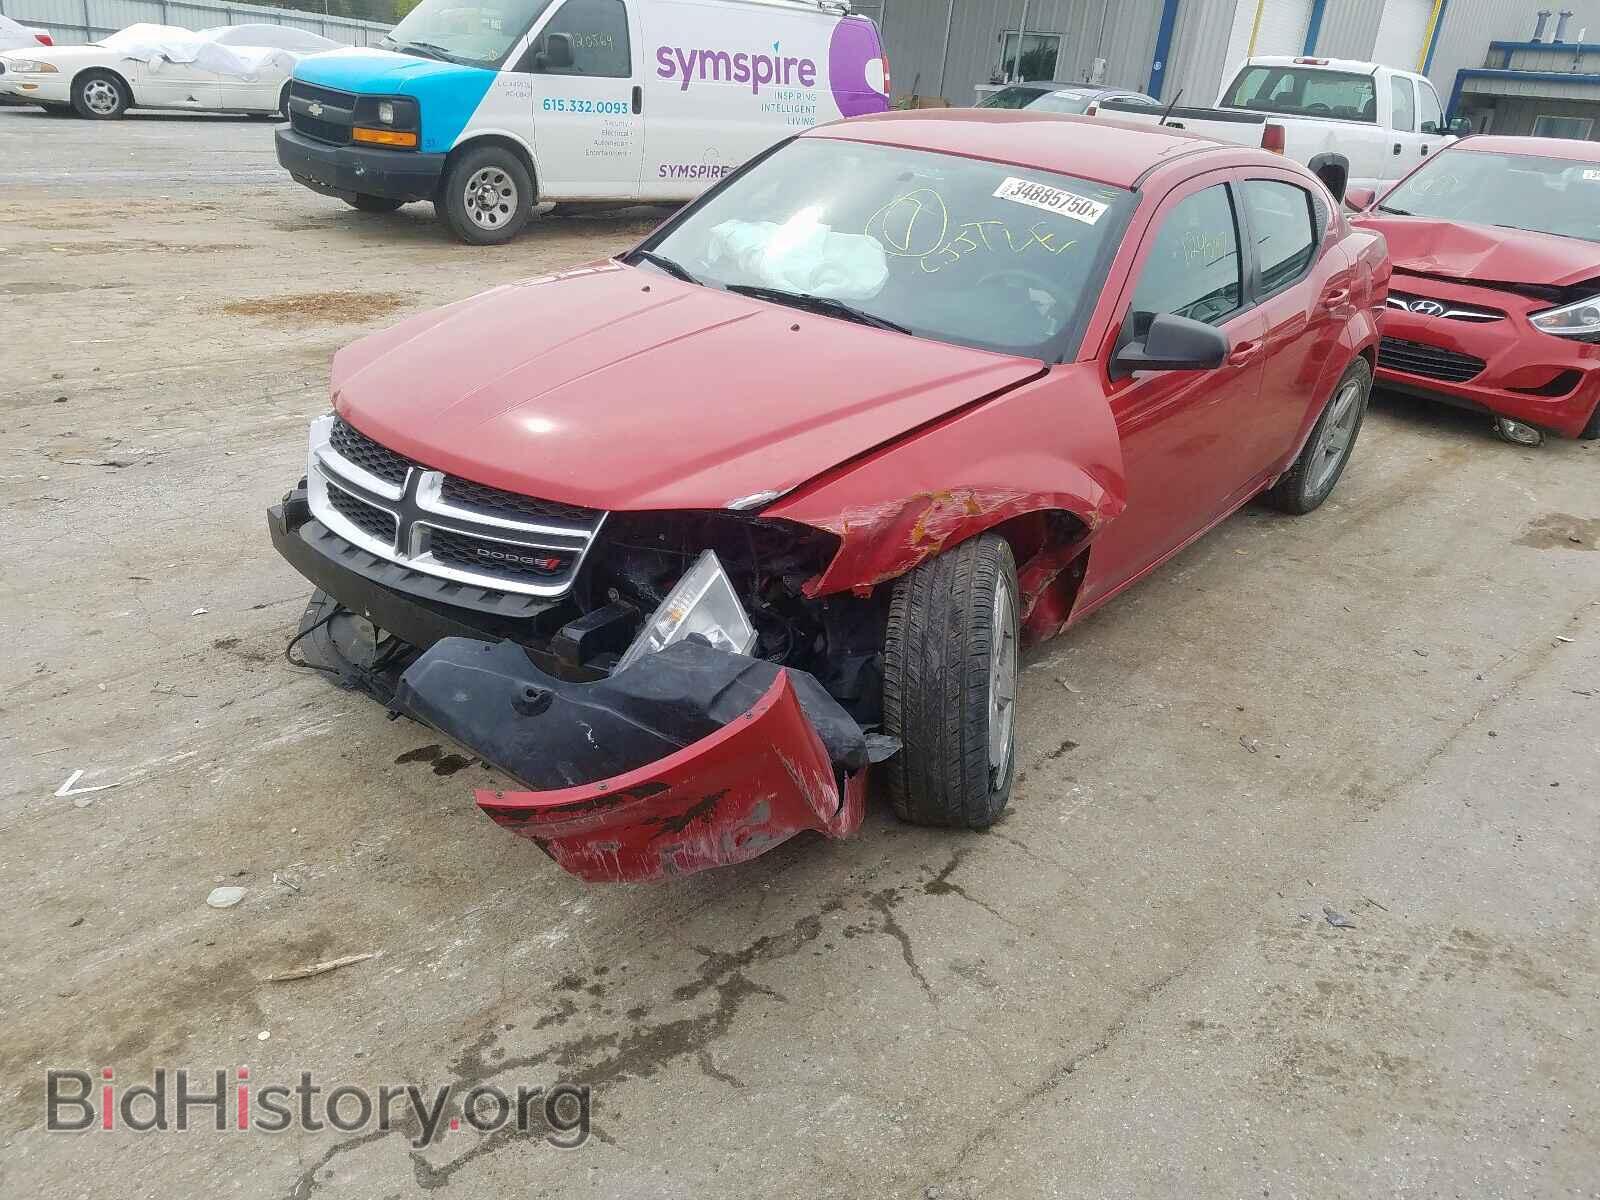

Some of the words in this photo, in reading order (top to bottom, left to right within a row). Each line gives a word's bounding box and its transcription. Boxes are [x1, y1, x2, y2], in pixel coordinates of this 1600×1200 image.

[656, 40, 817, 95] symspire
[774, 91, 817, 102] INSPIRING
[543, 98, 628, 114] 615.332.0093
[761, 103, 817, 114] INTELLIGENT
[787, 117, 816, 127] LIVING
[477, 548, 547, 567] DODGE
